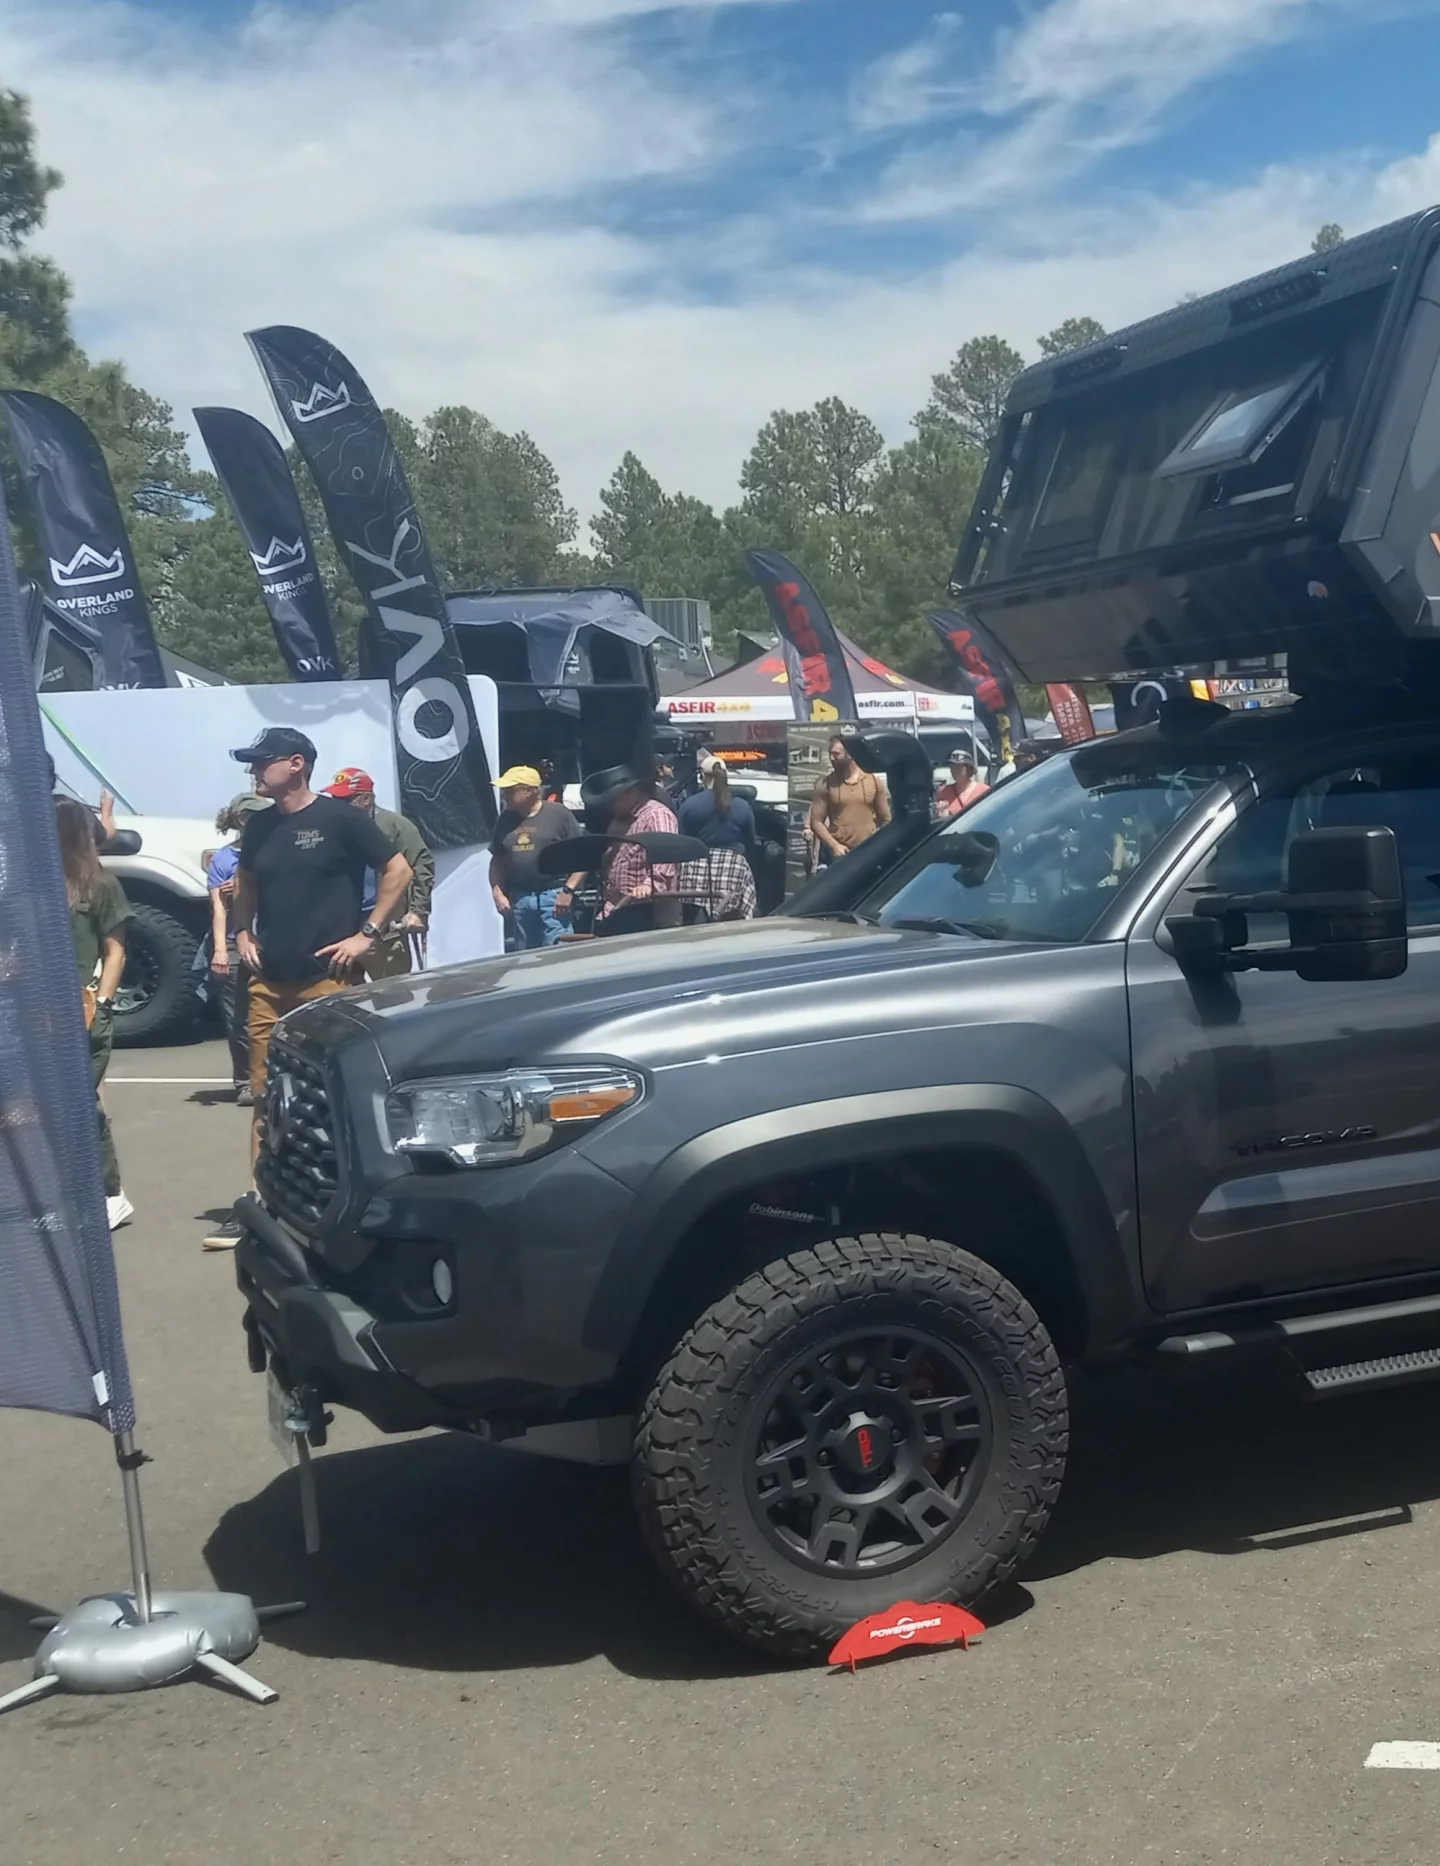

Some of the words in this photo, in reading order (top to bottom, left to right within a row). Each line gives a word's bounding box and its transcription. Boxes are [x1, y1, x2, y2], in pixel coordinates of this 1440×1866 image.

[56, 589, 134, 610] OVERLAND
[79, 603, 118, 617] KINGS
[345, 518, 469, 762] OVK
[668, 701, 716, 713] ASFIR
[748, 1202, 815, 1222] Dobinsons
